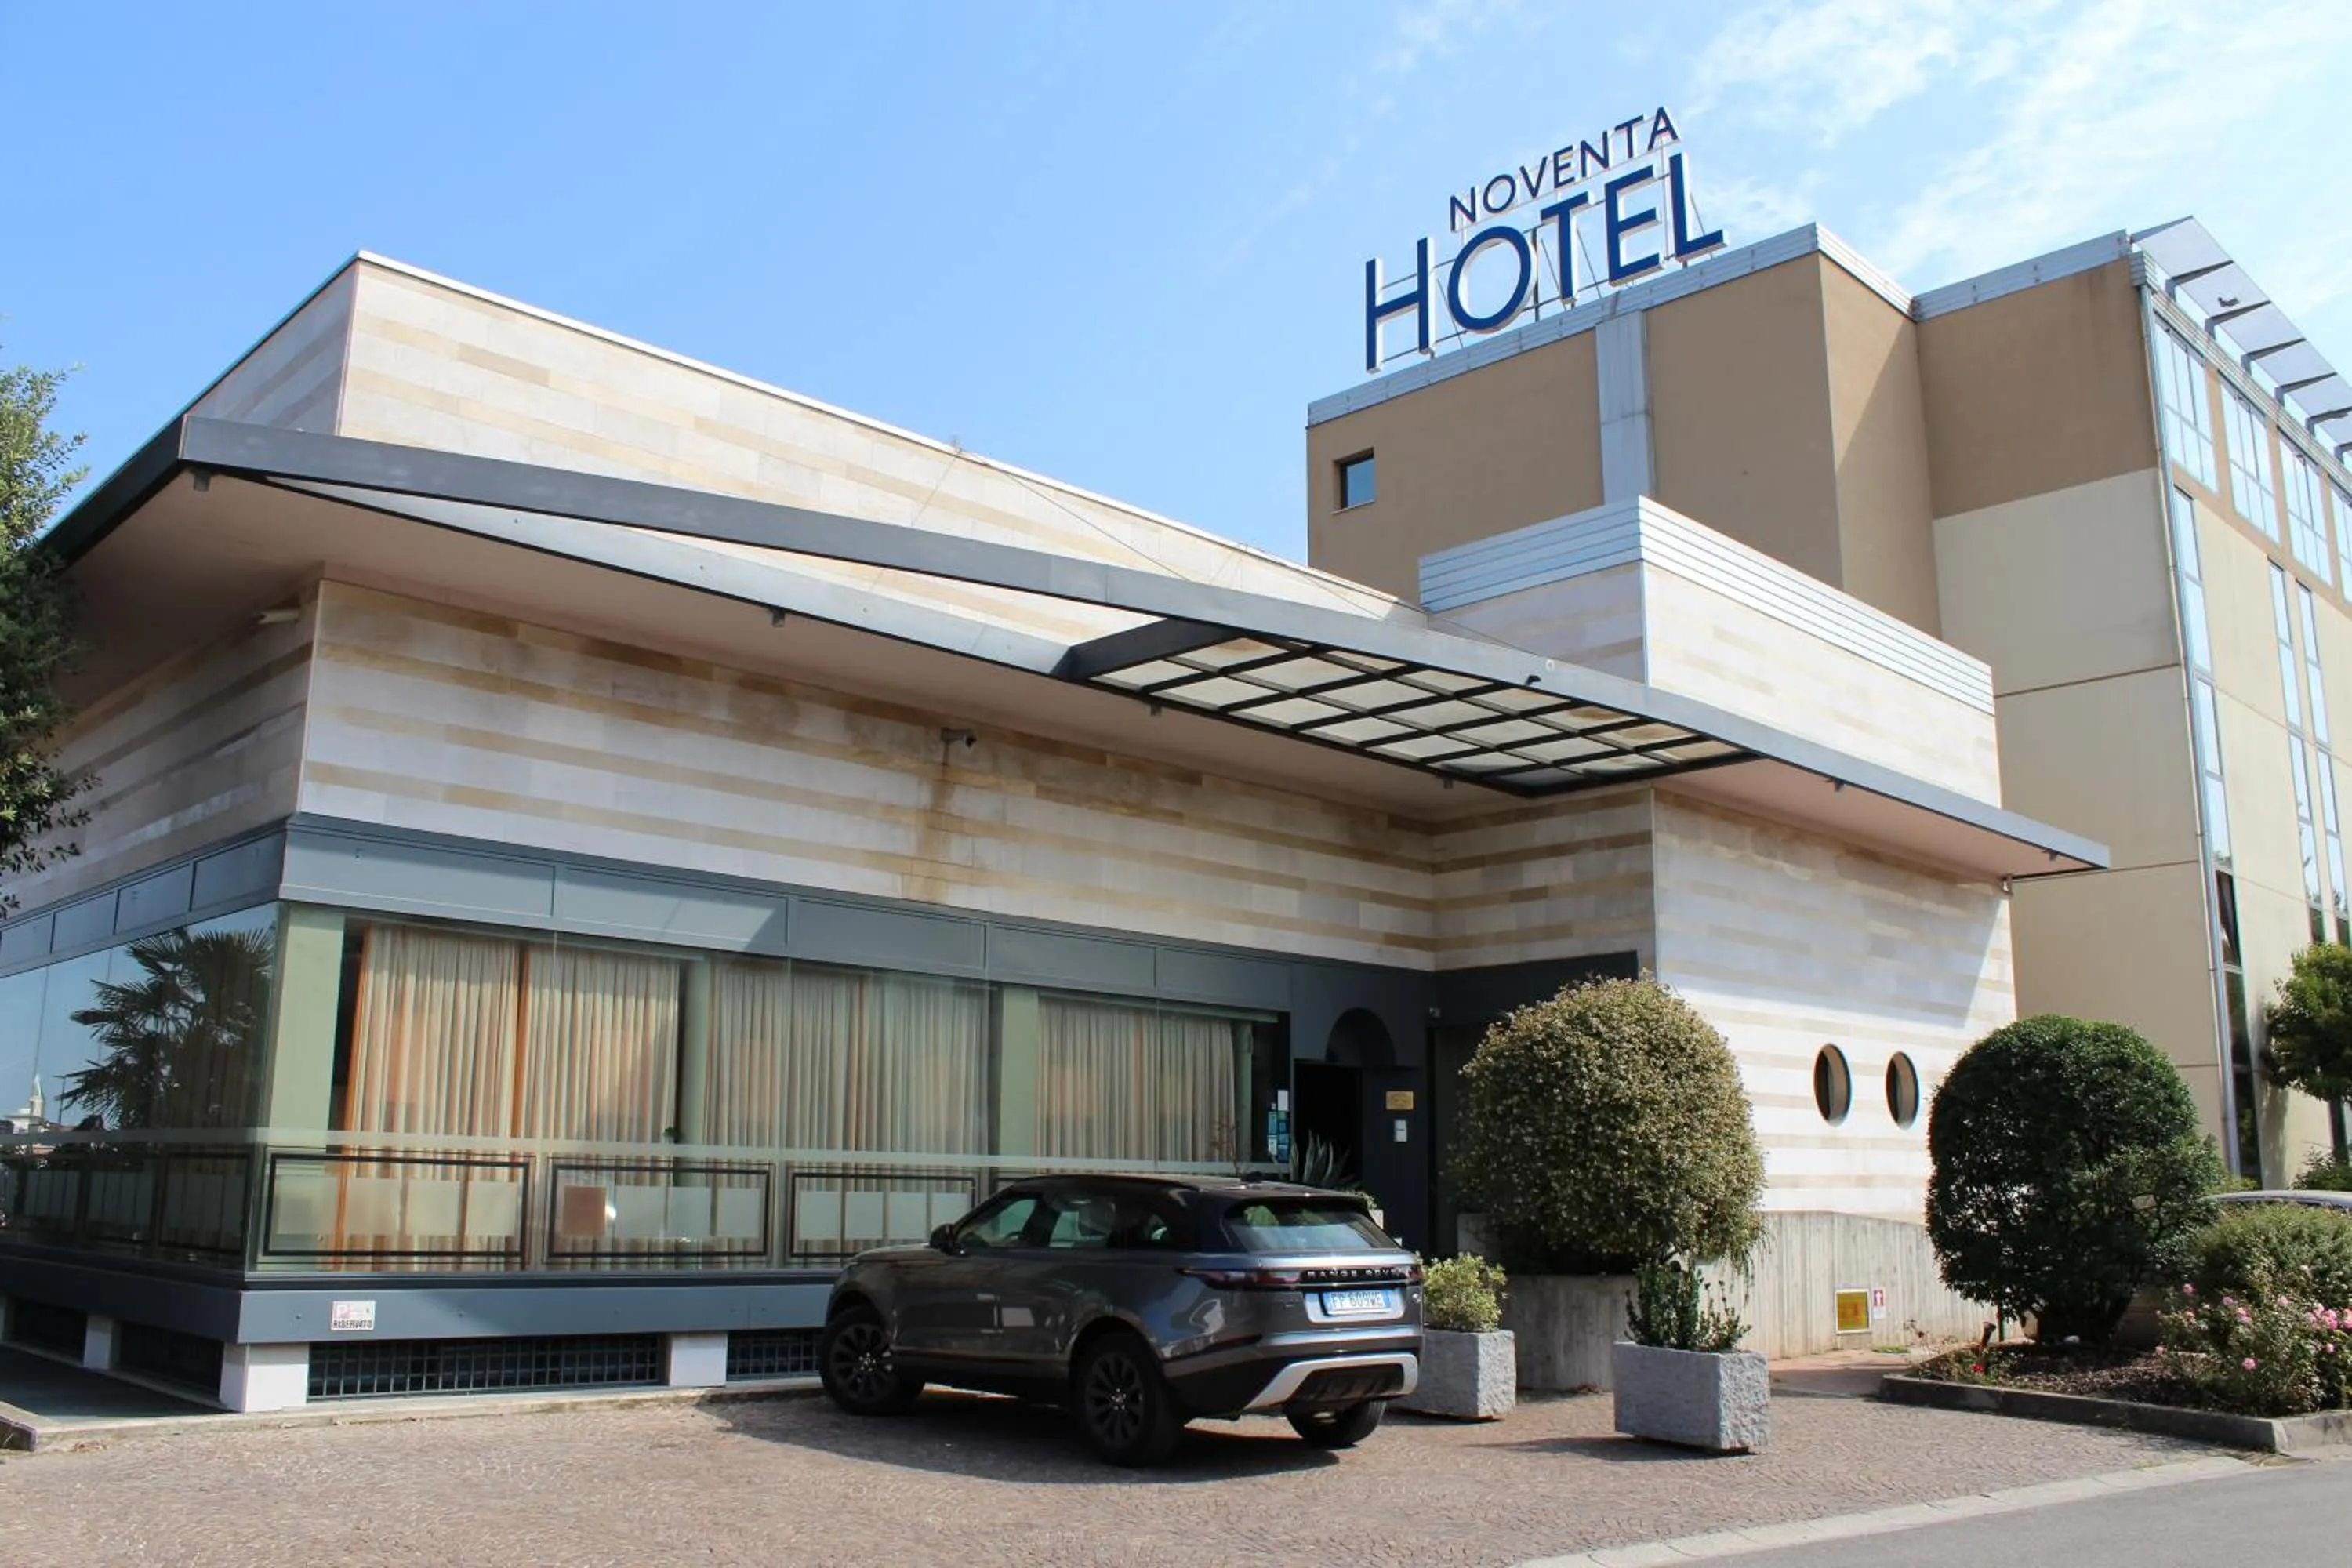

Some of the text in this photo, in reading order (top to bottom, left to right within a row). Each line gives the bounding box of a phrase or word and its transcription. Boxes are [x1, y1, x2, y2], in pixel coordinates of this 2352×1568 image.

[1450, 107, 1679, 231] NOVENTA
[1366, 152, 1726, 372] HOTEL
[1307, 1269, 1358, 1278] RANGE
